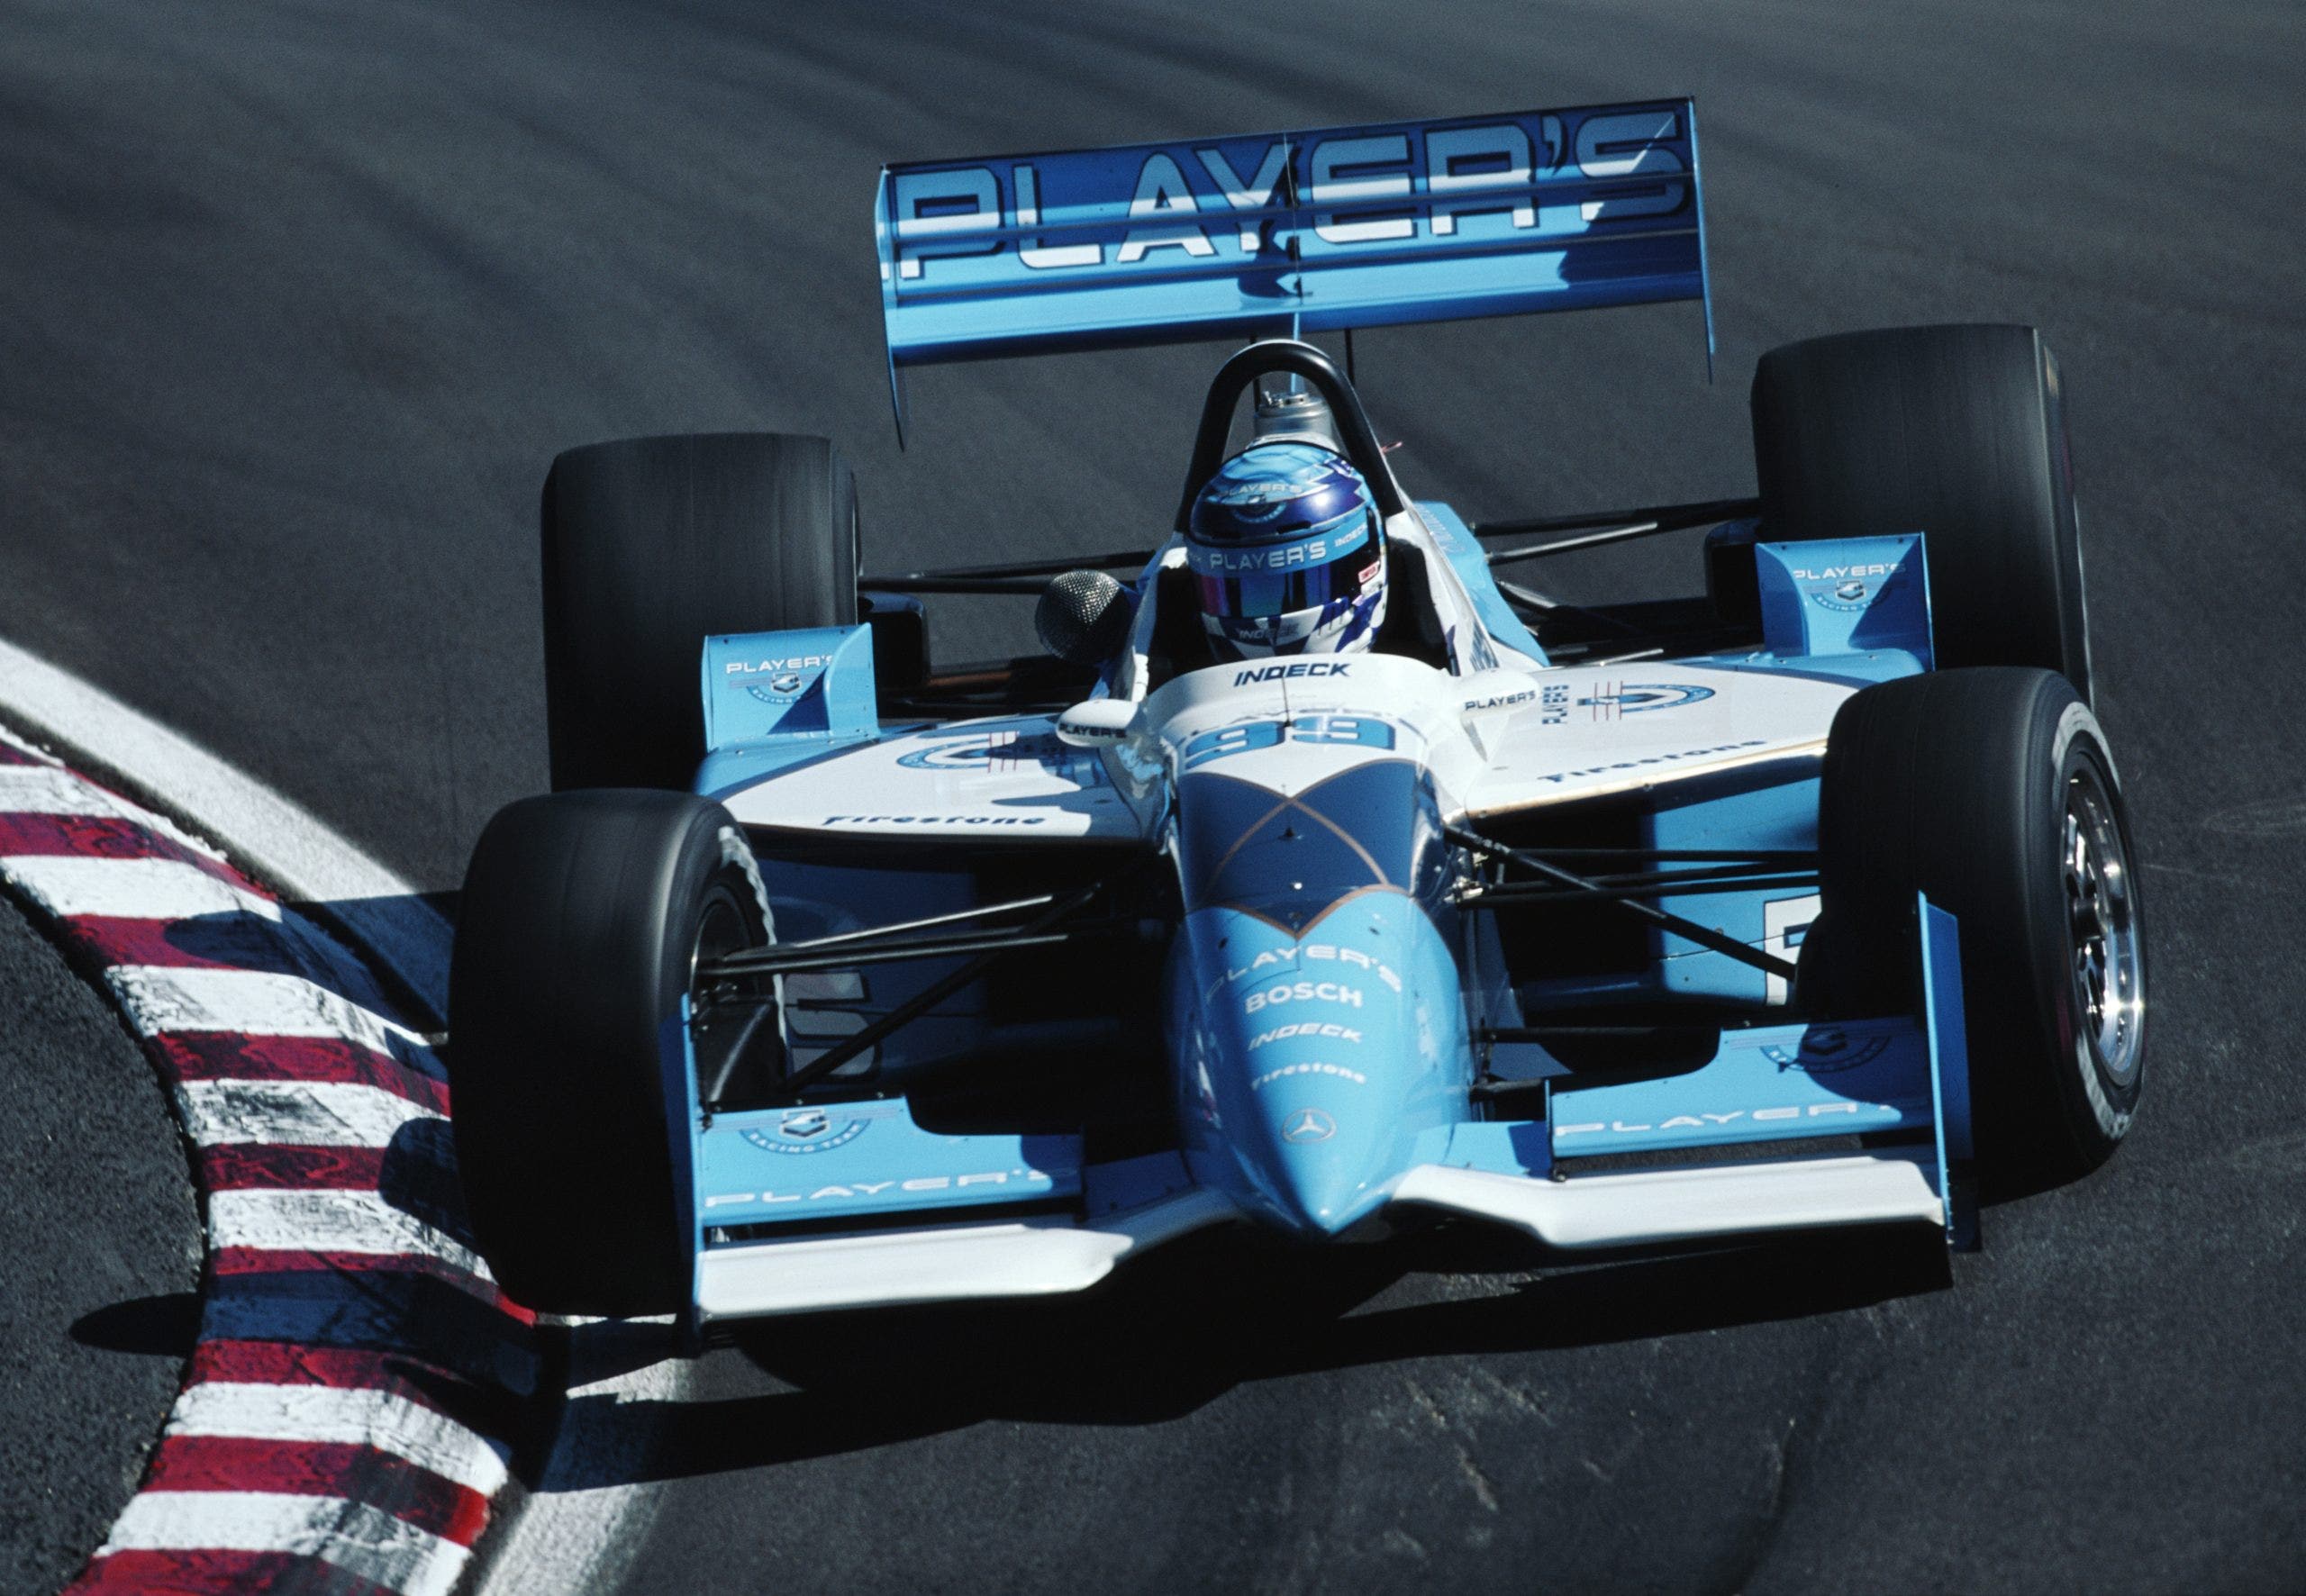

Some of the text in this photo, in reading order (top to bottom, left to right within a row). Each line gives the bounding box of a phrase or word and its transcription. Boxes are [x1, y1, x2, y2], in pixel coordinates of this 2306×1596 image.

[895, 111, 1688, 277] PLAYER'S
[1210, 541, 1326, 570] PLAYER'S
[1233, 663, 1352, 687] INDECK
[822, 814, 1046, 826] Firestone
[1205, 944, 1403, 1005] PLAYER'S
[1246, 982, 1364, 1015] BOSCH
[1248, 1022, 1363, 1052] INDECK
[1555, 1101, 1891, 1137] PLAYER
